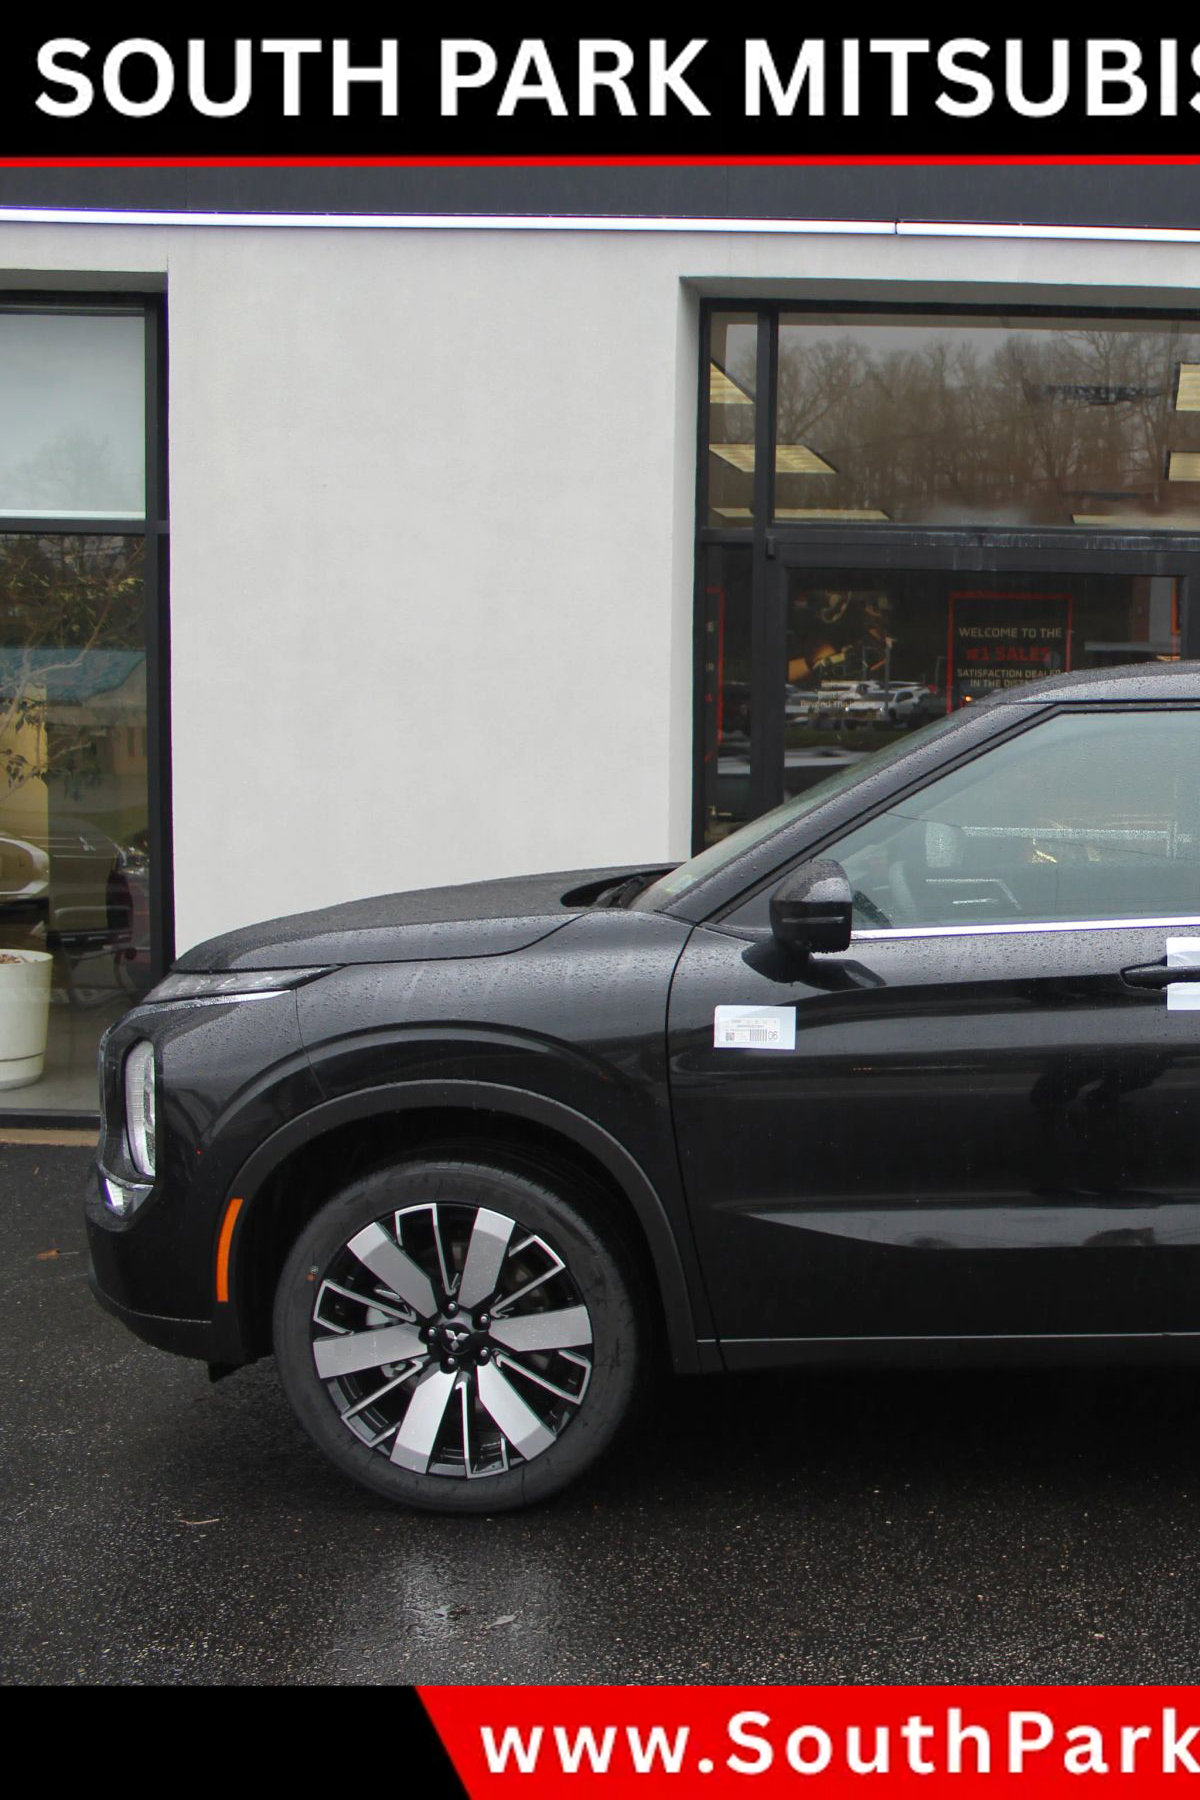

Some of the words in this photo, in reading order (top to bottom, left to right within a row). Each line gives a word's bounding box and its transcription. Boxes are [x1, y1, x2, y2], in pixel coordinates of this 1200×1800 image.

[959, 627, 1017, 638] WELCOME
[1022, 627, 1036, 638] TO
[1039, 627, 1062, 638] THE
[957, 668, 1022, 678] SATISFACTION
